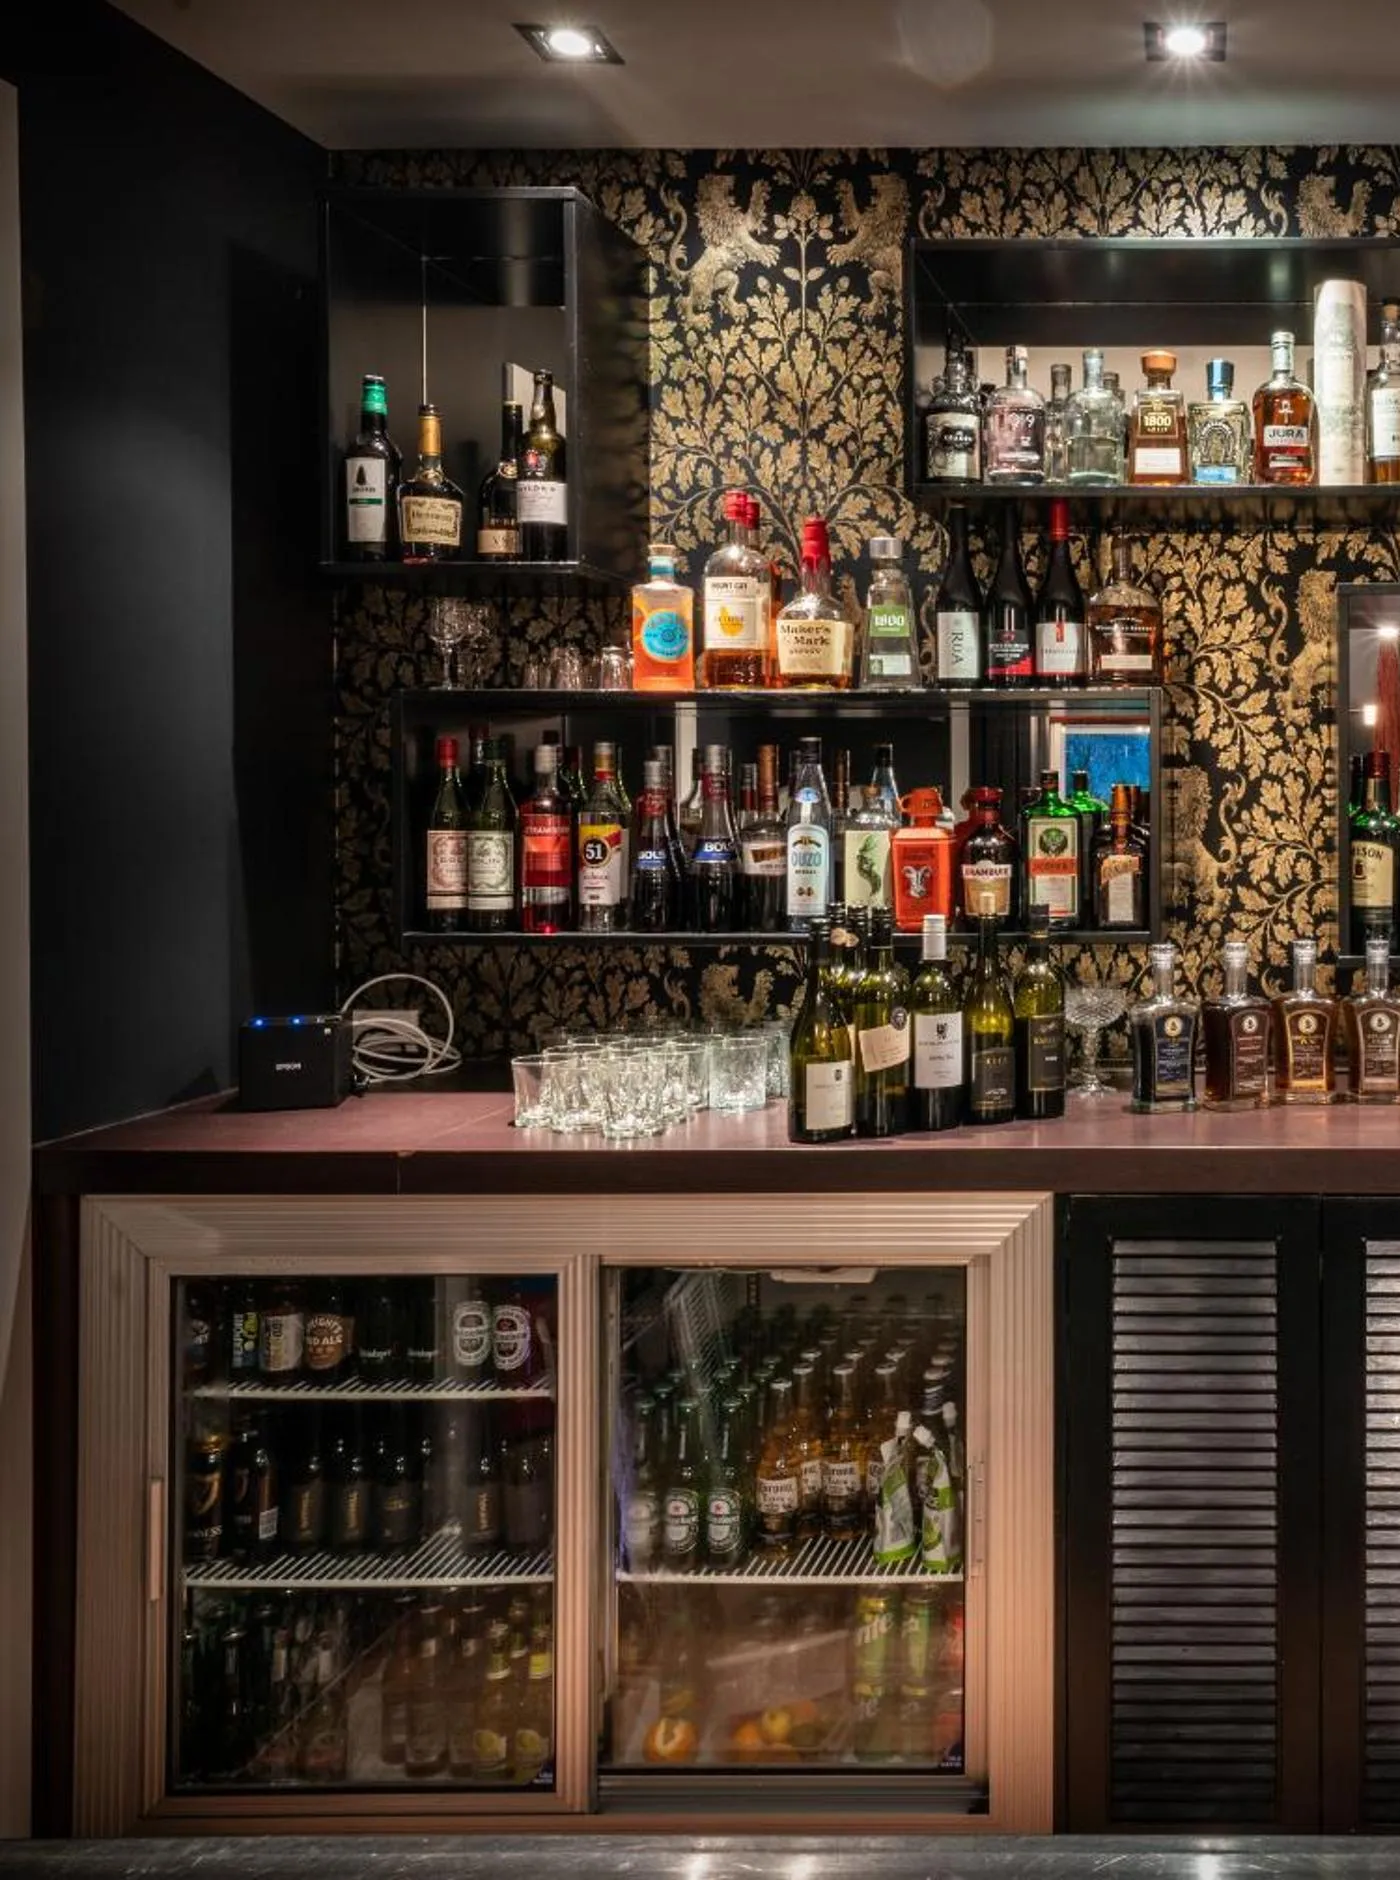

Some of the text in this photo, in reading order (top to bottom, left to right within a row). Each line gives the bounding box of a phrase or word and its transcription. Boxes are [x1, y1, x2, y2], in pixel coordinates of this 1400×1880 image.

[1144, 415, 1172, 427] 1800
[1269, 428, 1305, 440] JURA
[875, 615, 904, 627] 1800
[780, 624, 831, 635] Maker's
[804, 636, 830, 646] Mark
[951, 631, 964, 665] RUA
[585, 844, 604, 860] 51
[791, 851, 822, 867] OUZO
[964, 867, 1009, 878] DRAMBUIE
